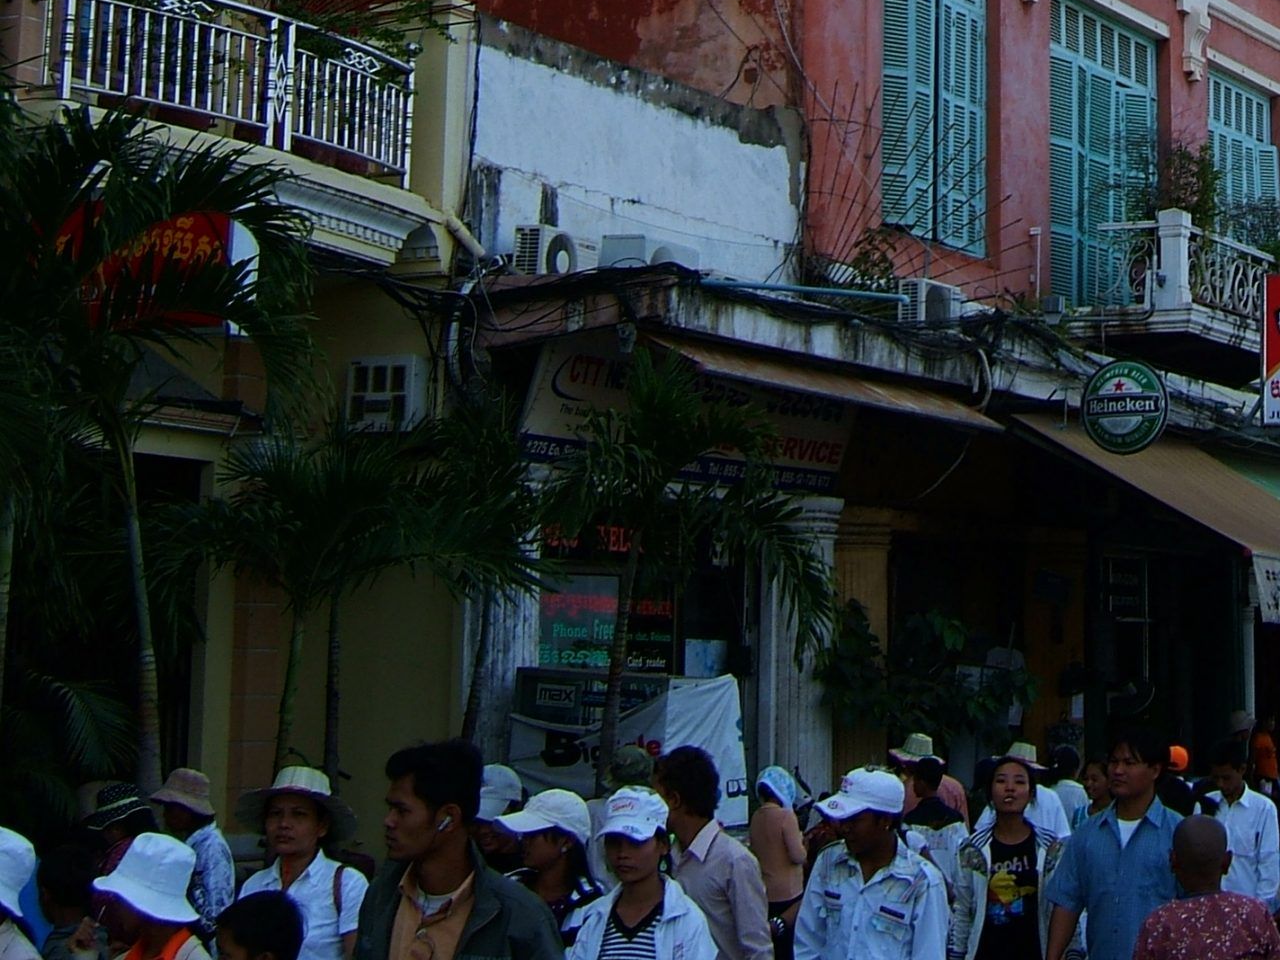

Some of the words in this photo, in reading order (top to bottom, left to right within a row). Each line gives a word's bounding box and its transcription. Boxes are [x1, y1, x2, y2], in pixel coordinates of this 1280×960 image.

[569, 353, 606, 387] CTT
[1089, 397, 1156, 414] Heineken
[552, 623, 588, 638] Phone
[540, 688, 575, 702] max
